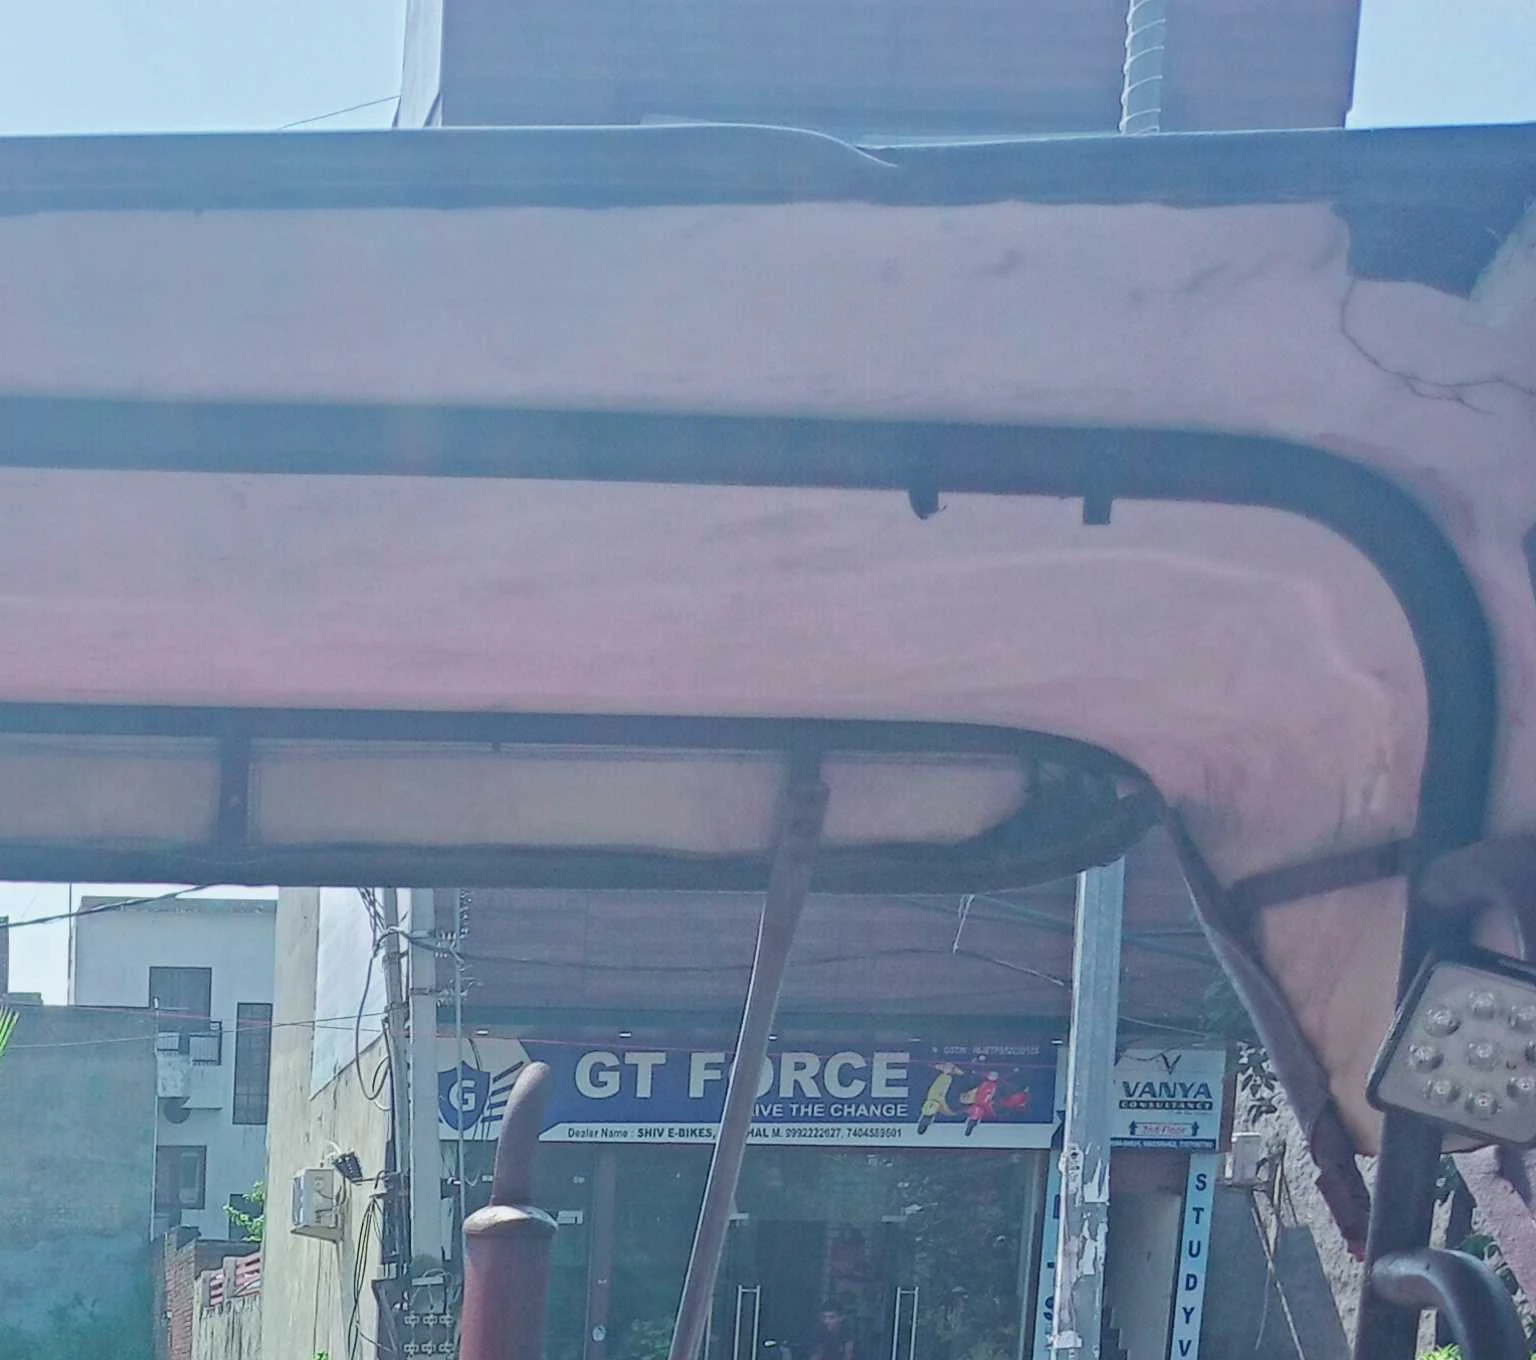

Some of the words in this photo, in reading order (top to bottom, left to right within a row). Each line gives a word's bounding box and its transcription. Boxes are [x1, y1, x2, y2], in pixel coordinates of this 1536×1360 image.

[574, 1050, 667, 1100] GT
[1122, 1081, 1212, 1099] VANYA
[751, 1103, 784, 1118] IVE
[789, 1103, 825, 1118] THE
[830, 1103, 909, 1118] CHANGE
[568, 1127, 599, 1138] Dealer
[637, 1127, 665, 1139] SHIV
